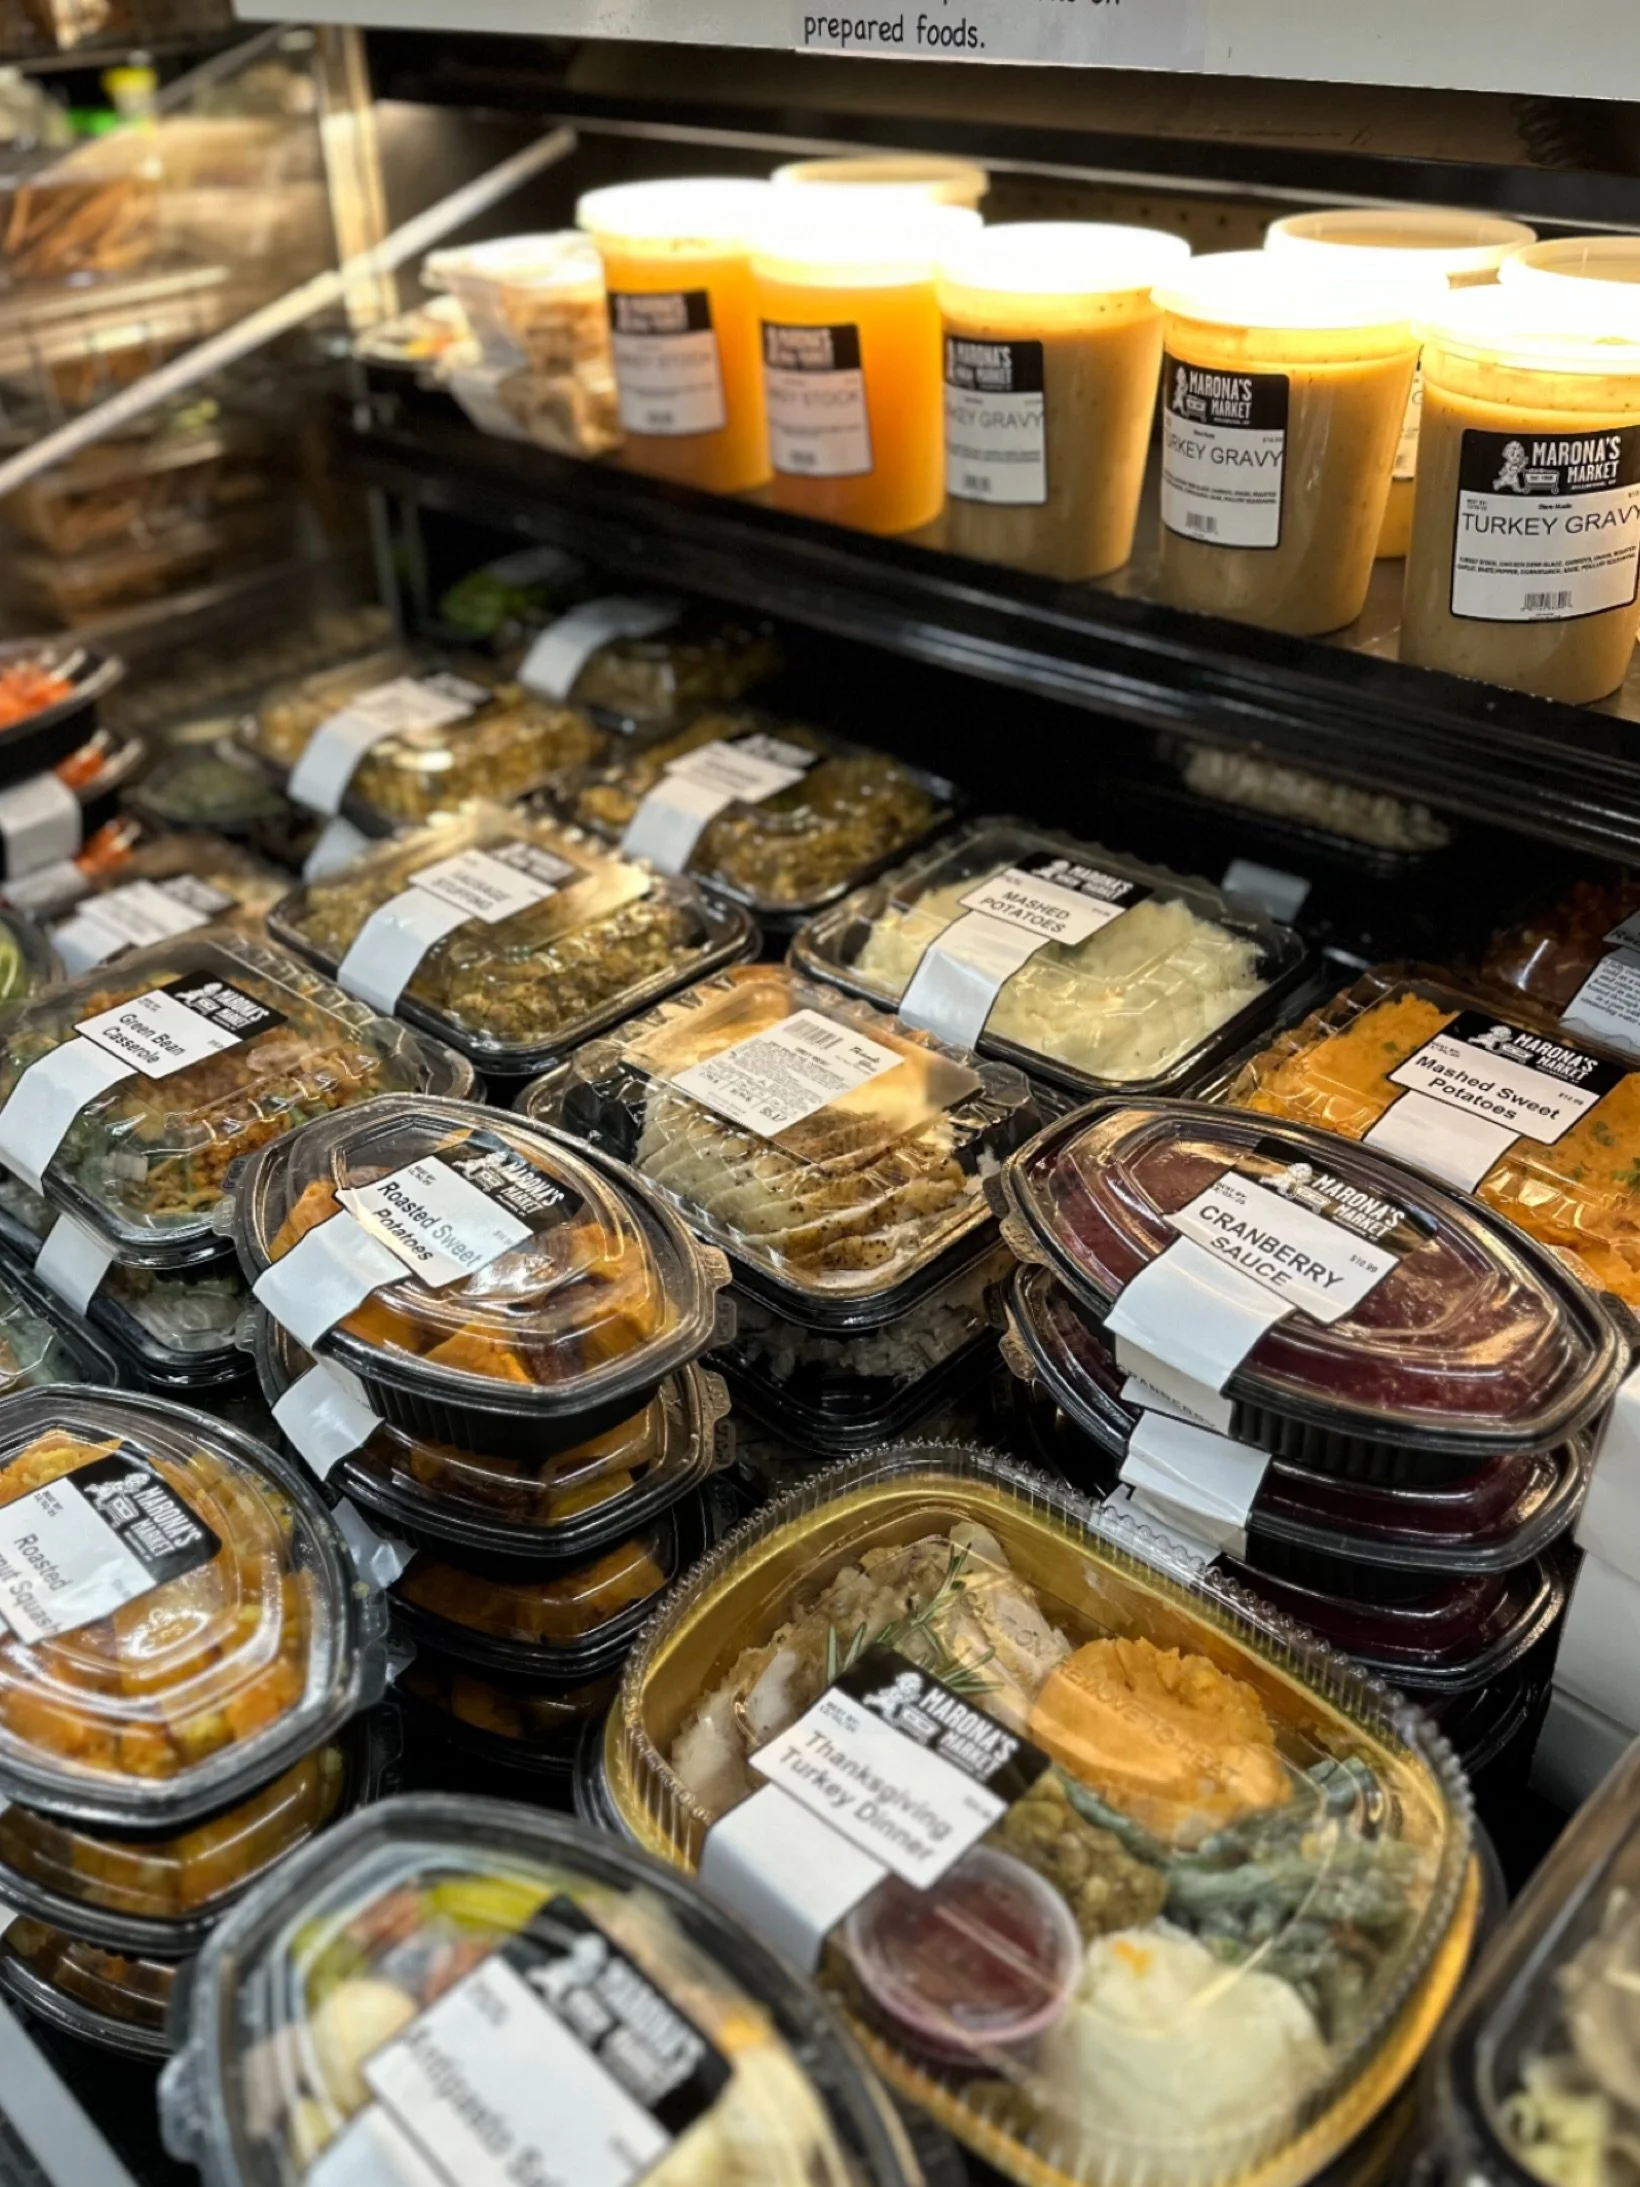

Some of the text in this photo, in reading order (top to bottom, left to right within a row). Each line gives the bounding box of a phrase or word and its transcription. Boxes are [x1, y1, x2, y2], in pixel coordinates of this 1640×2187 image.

[804, 14, 985, 48] prepared foods.
[1189, 370, 1252, 401] MARONA'S
[1211, 398, 1252, 419] MARKET
[1210, 446, 1284, 468] GRAVY
[1531, 436, 1621, 467] MARONA'S
[1567, 460, 1619, 484] MARKET
[1462, 513, 1558, 536] TURKEY
[979, 897, 1066, 933] POTATOES
[1001, 891, 1070, 920] MASHED
[119, 1013, 155, 1039] Green
[151, 1033, 185, 1057] Bean
[1514, 1033, 1598, 1073] MARONA'S
[1416, 1055, 1560, 1120] Mashed Sweet
[1536, 1055, 1589, 1083] MARKET
[1428, 1076, 1517, 1121] Potatoes
[501, 1162, 565, 1208] MARONA'S
[1311, 1174, 1405, 1229] MARONA'S
[373, 1207, 435, 1261] Potatoes
[377, 1181, 484, 1268] Roasted Sweet
[1333, 1203, 1393, 1238] MARKET
[1199, 1204, 1344, 1290] CRANBERRY
[1211, 1236, 1293, 1288] SAUCE
[129, 1518, 176, 1557] MARKET
[132, 1485, 203, 1549] MARONA'S
[14, 1533, 74, 1591] Roasted
[9, 1580, 62, 1633] Squash
[919, 1687, 1019, 1763] MARONA'S
[935, 1730, 1002, 1777] MARKET
[779, 1745, 937, 1863] Turkey Dinner
[805, 1730, 953, 1843] Thanksgiving
